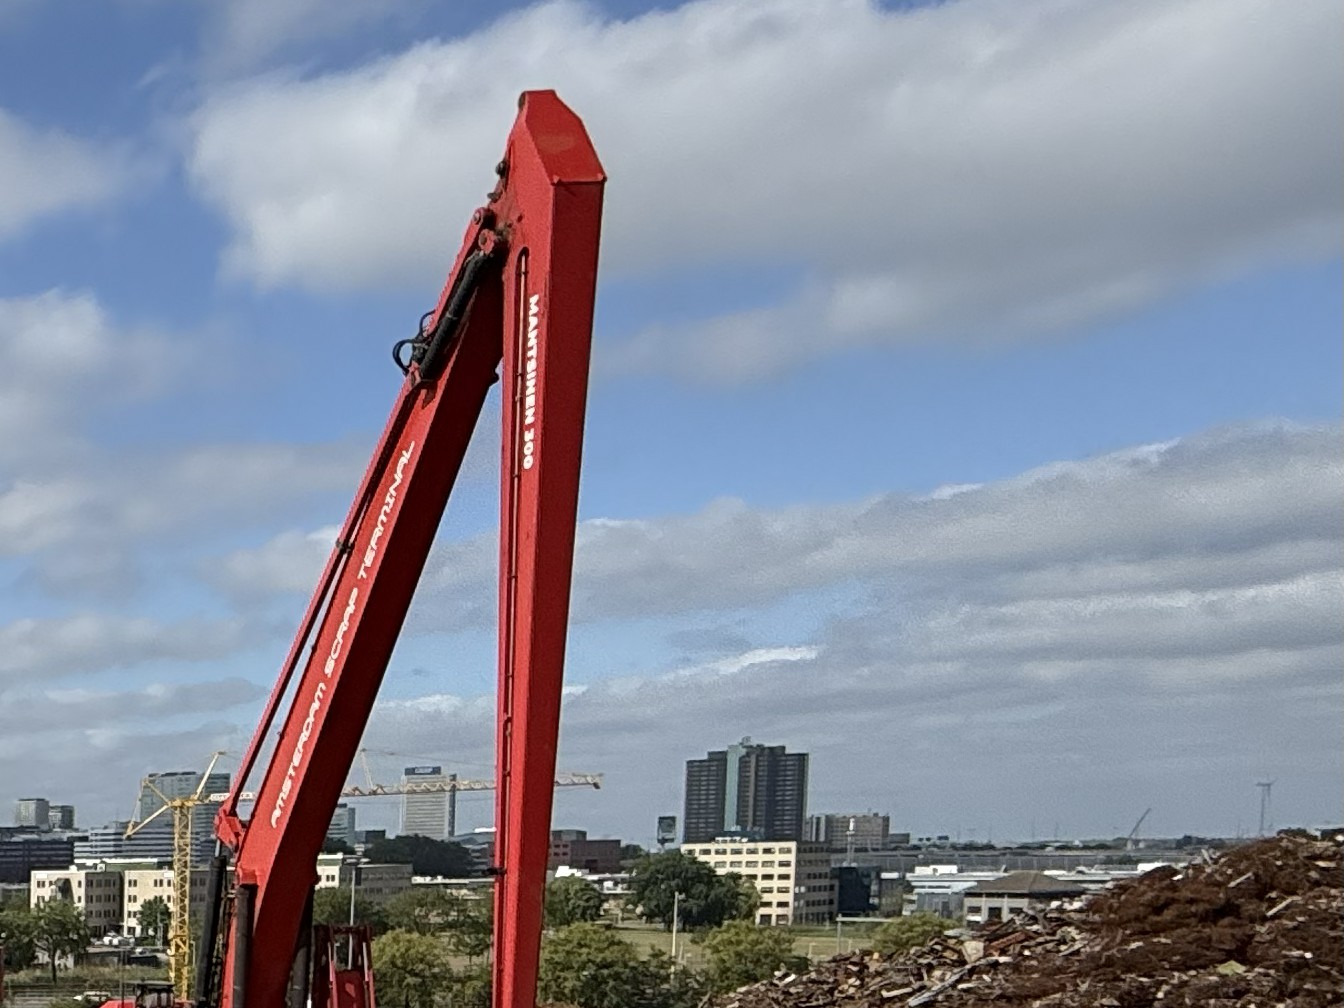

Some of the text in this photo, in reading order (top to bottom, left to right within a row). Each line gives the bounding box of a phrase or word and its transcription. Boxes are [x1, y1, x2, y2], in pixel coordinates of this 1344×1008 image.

[522, 294, 540, 470] MANTSINEN 300
[270, 441, 415, 829] AMSTERDAM SCRAP TERMINAL
